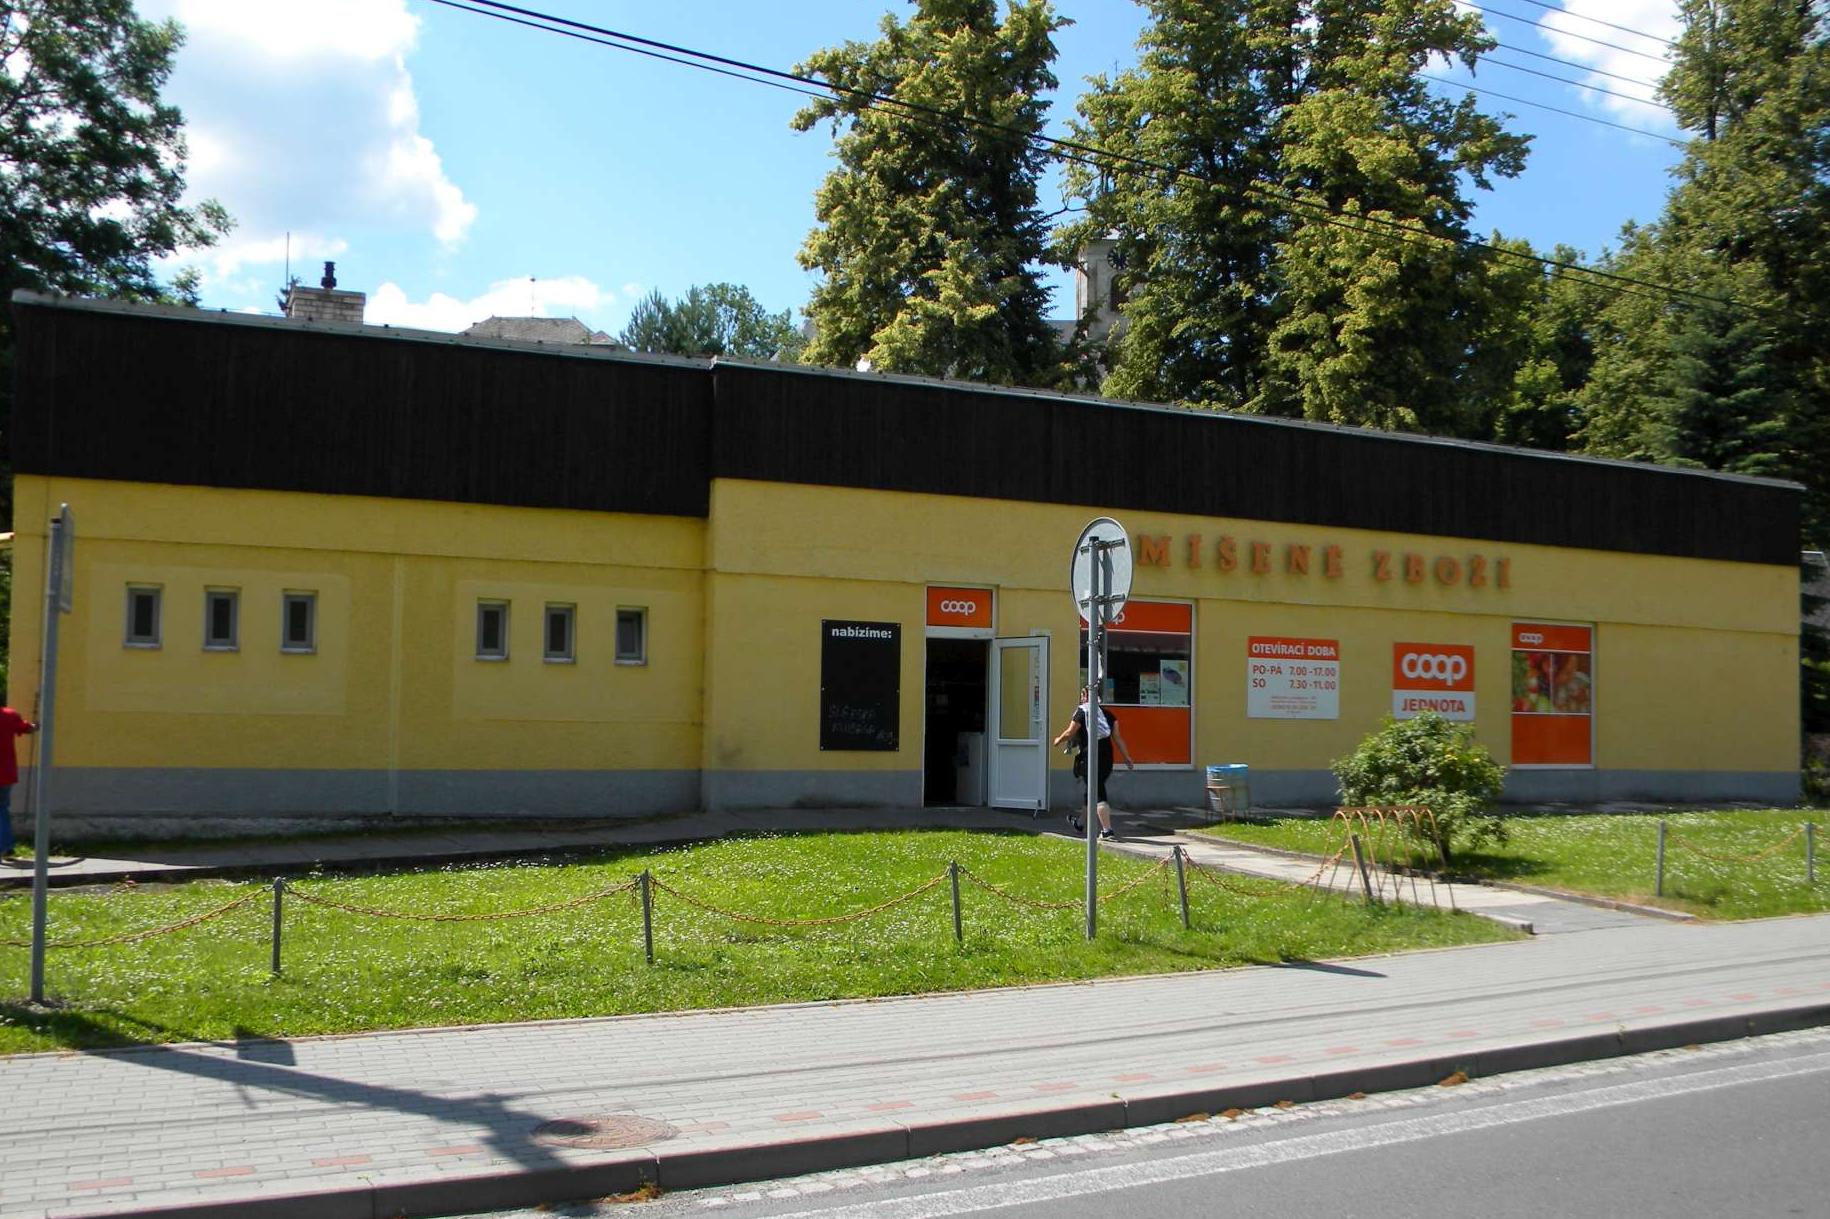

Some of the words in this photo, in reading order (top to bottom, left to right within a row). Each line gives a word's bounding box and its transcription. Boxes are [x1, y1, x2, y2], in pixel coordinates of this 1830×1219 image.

[941, 600, 976, 615] coop
[1307, 645, 1337, 656] DOBA
[1401, 652, 1467, 687] coop
[1252, 678, 1266, 688] SO
[1402, 698, 1466, 713] JEDNOTA
